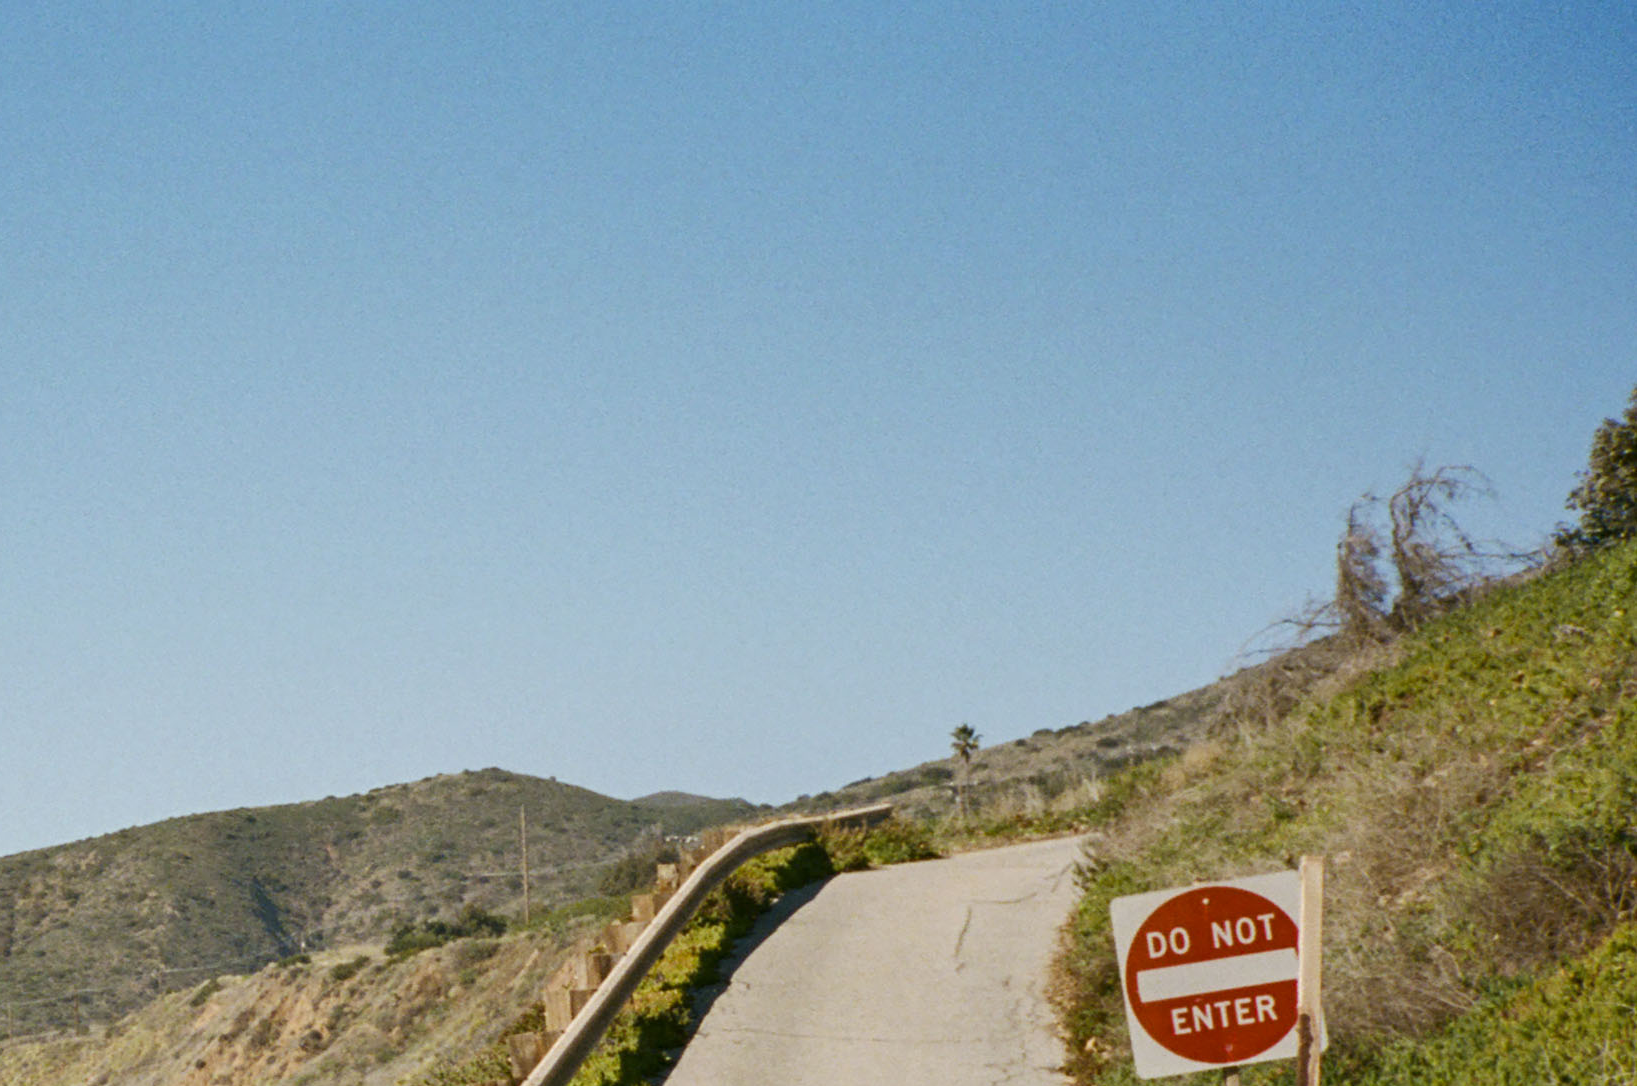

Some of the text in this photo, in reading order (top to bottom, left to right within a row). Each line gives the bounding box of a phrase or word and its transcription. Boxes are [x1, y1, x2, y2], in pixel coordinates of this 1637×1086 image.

[1146, 913, 1275, 959] DO NOT
[1170, 994, 1278, 1036] ENTER
